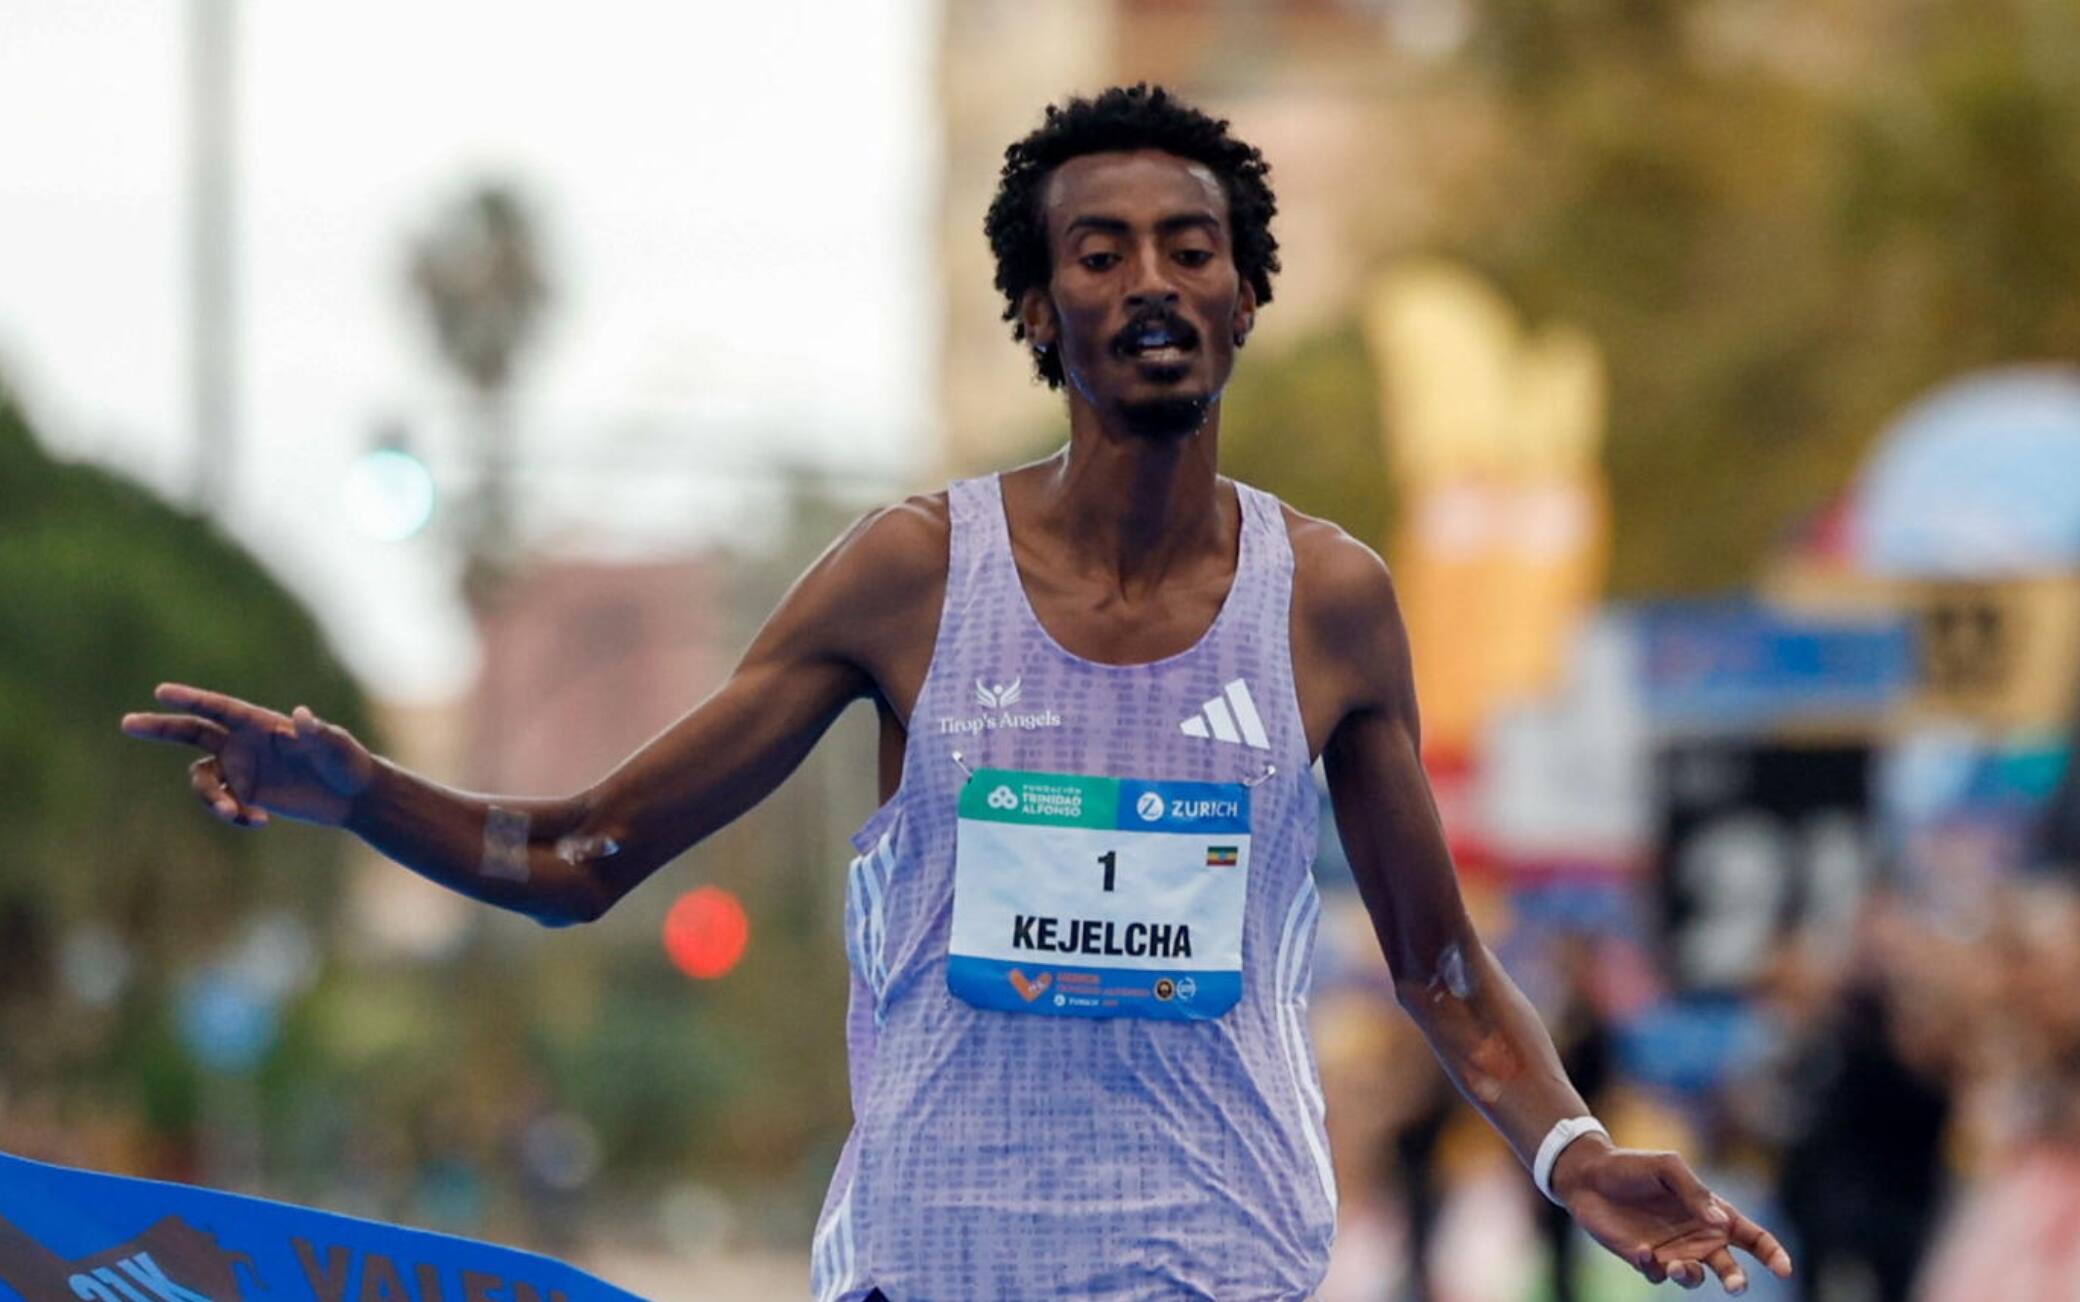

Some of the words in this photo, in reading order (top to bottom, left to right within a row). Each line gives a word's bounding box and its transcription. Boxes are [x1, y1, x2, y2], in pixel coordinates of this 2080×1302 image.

[938, 712, 996, 736] Tirop's
[999, 710, 1061, 730] Angels
[1022, 793, 1082, 806] TRINIDAD
[1022, 804, 1082, 817] ALFONSO
[1171, 799, 1238, 818] ZURICH
[1096, 849, 1117, 892] 1
[1012, 914, 1193, 959] KEJELCHA
